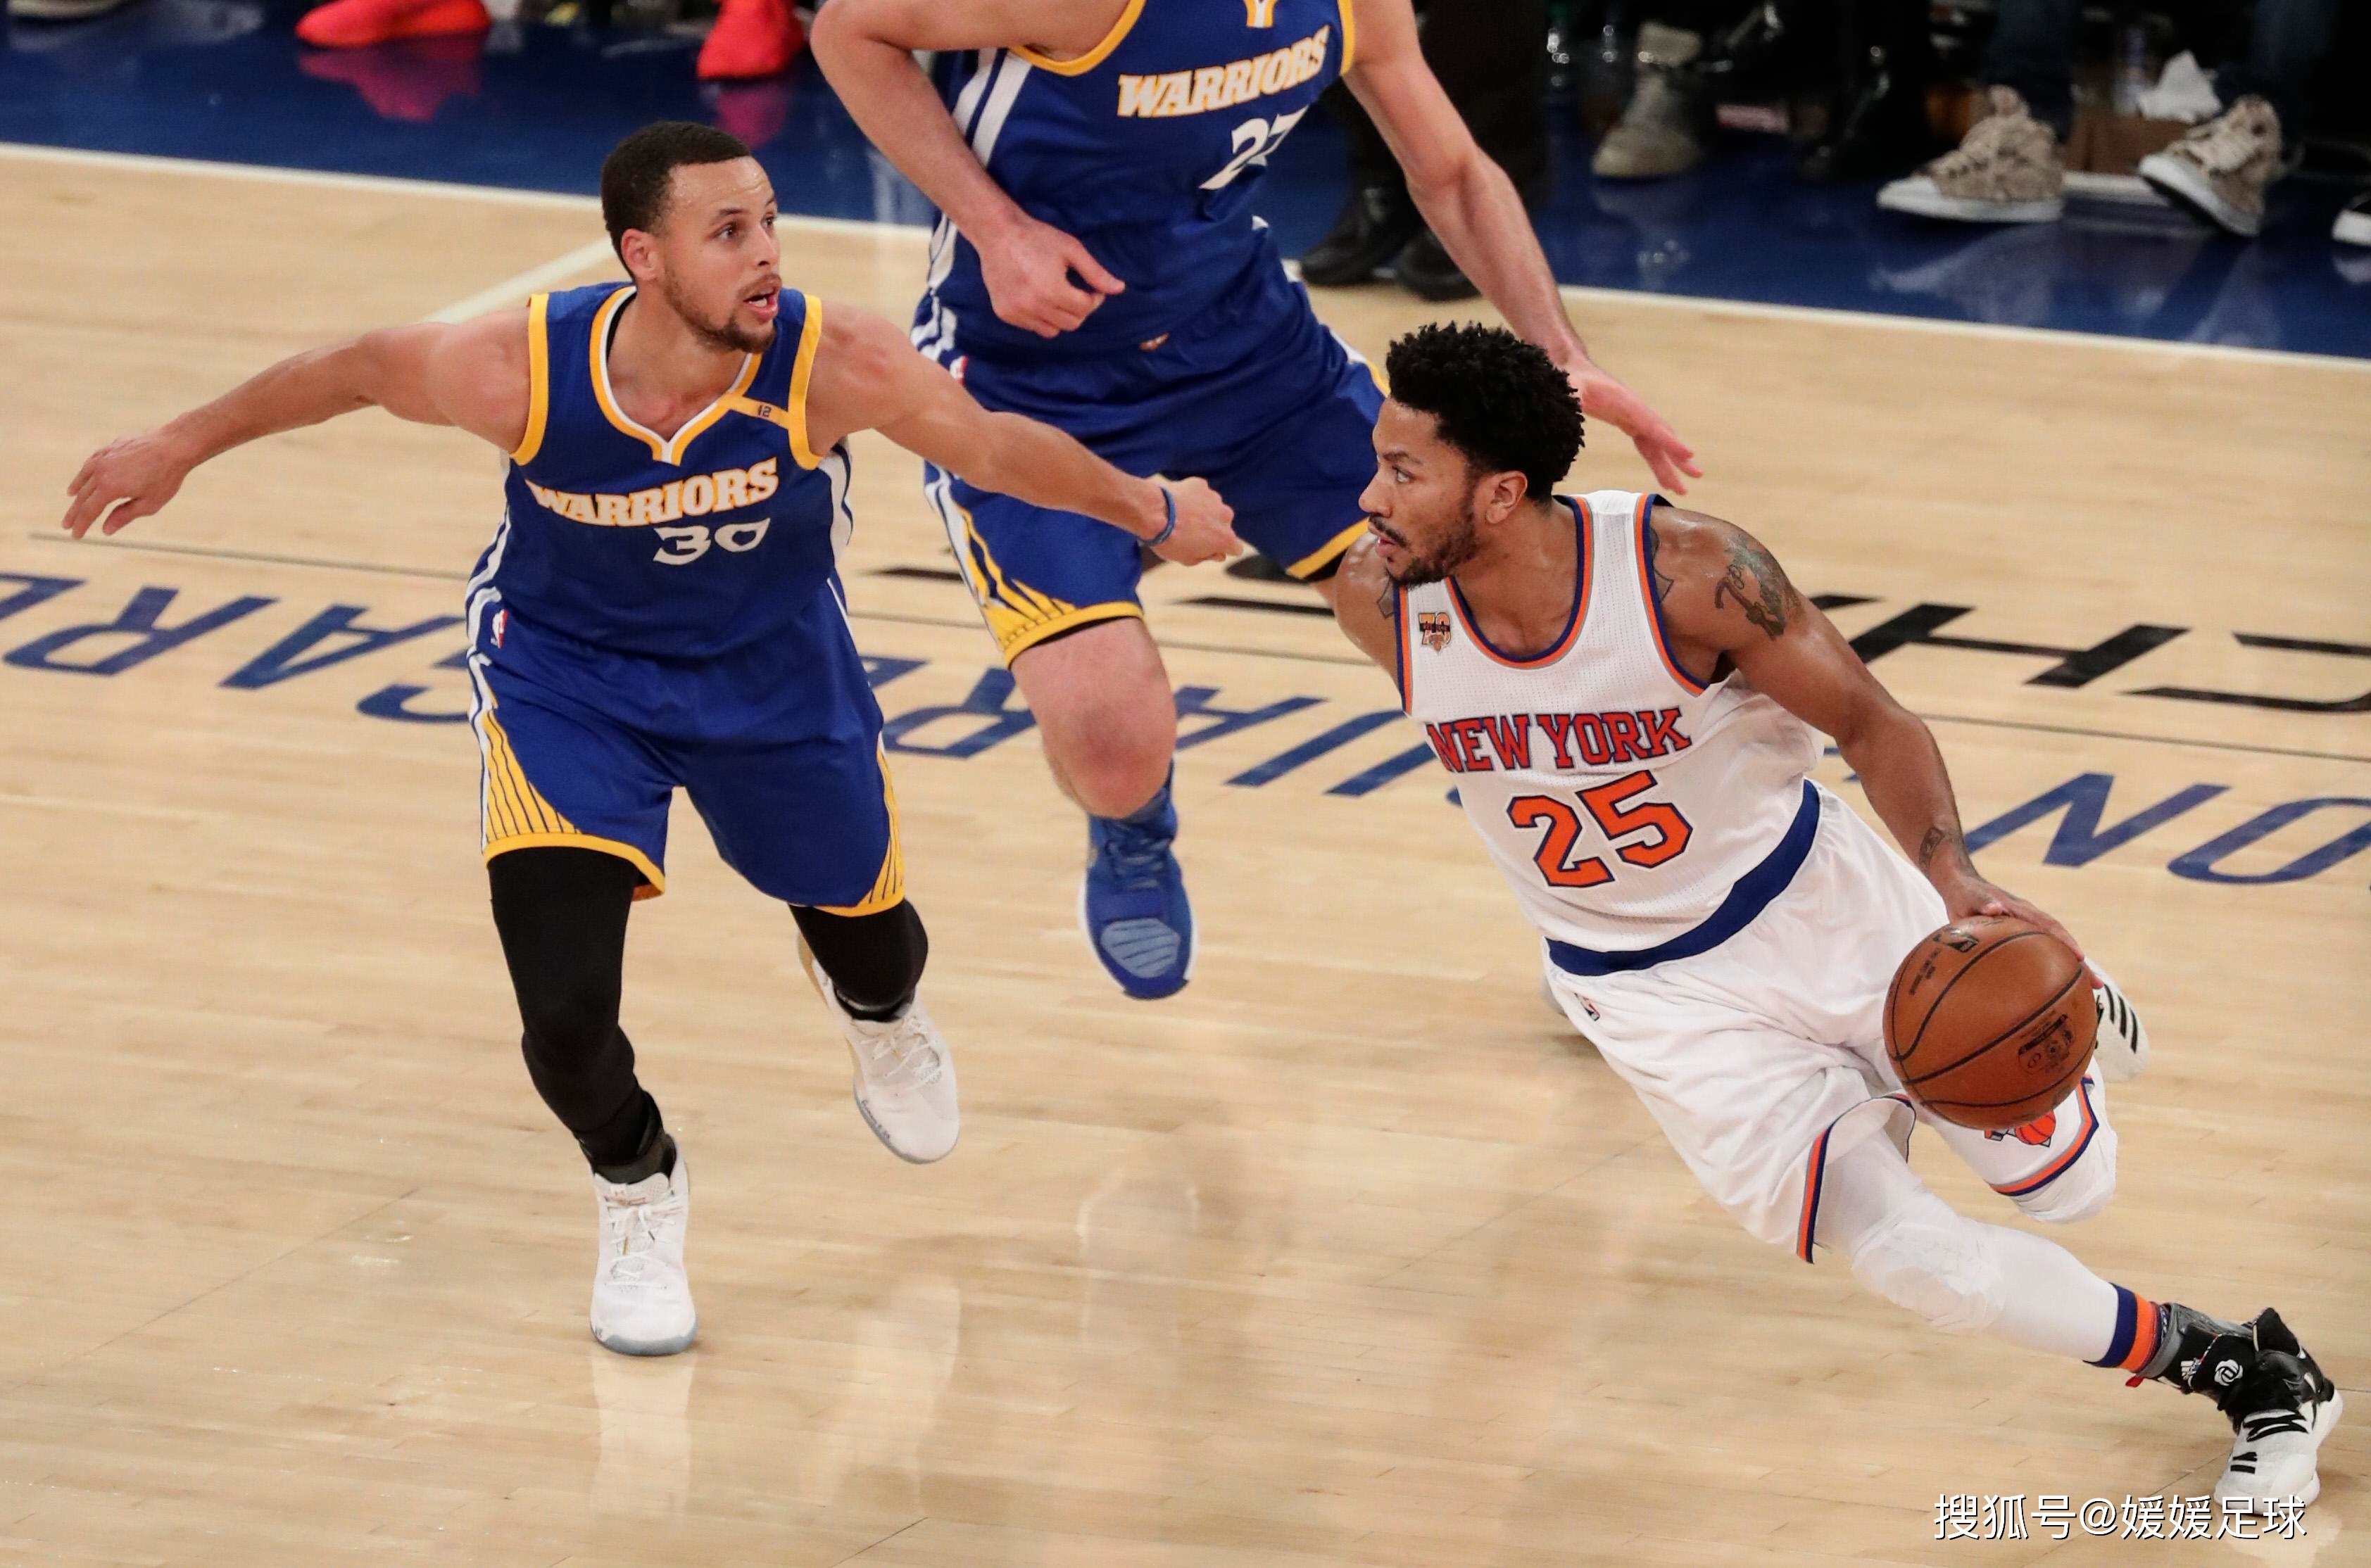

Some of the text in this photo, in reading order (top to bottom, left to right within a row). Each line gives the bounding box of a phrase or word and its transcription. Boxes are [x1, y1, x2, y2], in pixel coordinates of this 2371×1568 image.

[1117, 25, 1330, 118] WARRIORS
[1199, 104, 1309, 191] 27
[524, 457, 779, 527] WARRIORS
[653, 517, 771, 566] 30
[1426, 705, 1692, 773] NEW YORK
[1506, 769, 1694, 888] 25
